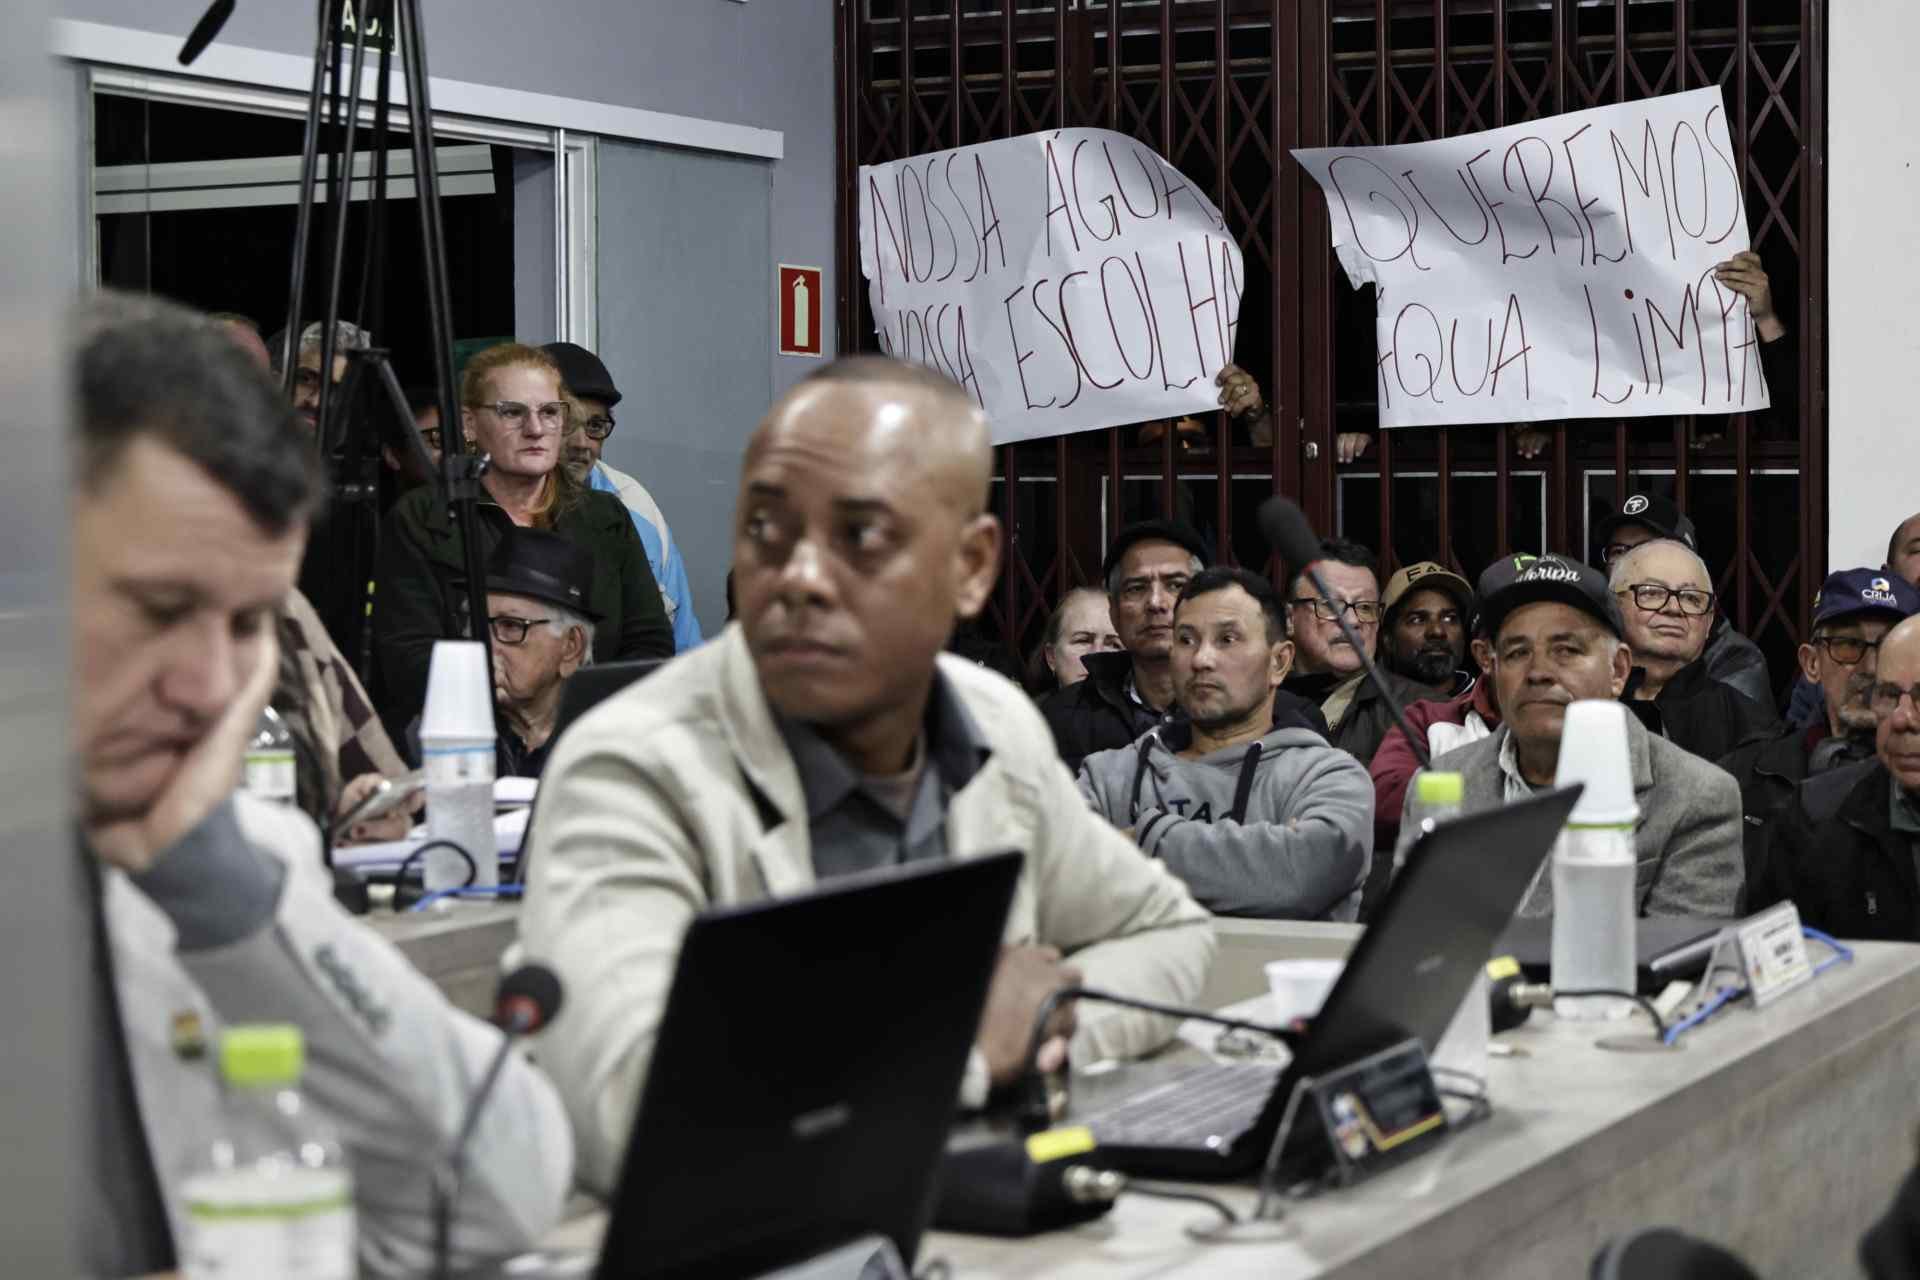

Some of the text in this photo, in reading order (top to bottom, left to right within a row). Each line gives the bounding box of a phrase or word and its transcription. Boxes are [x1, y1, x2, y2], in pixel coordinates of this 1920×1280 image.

[869, 152, 1006, 305] NOSSA
[1328, 104, 1740, 271] QUEREMOS
[1004, 234, 1242, 411] ESCOLHA
